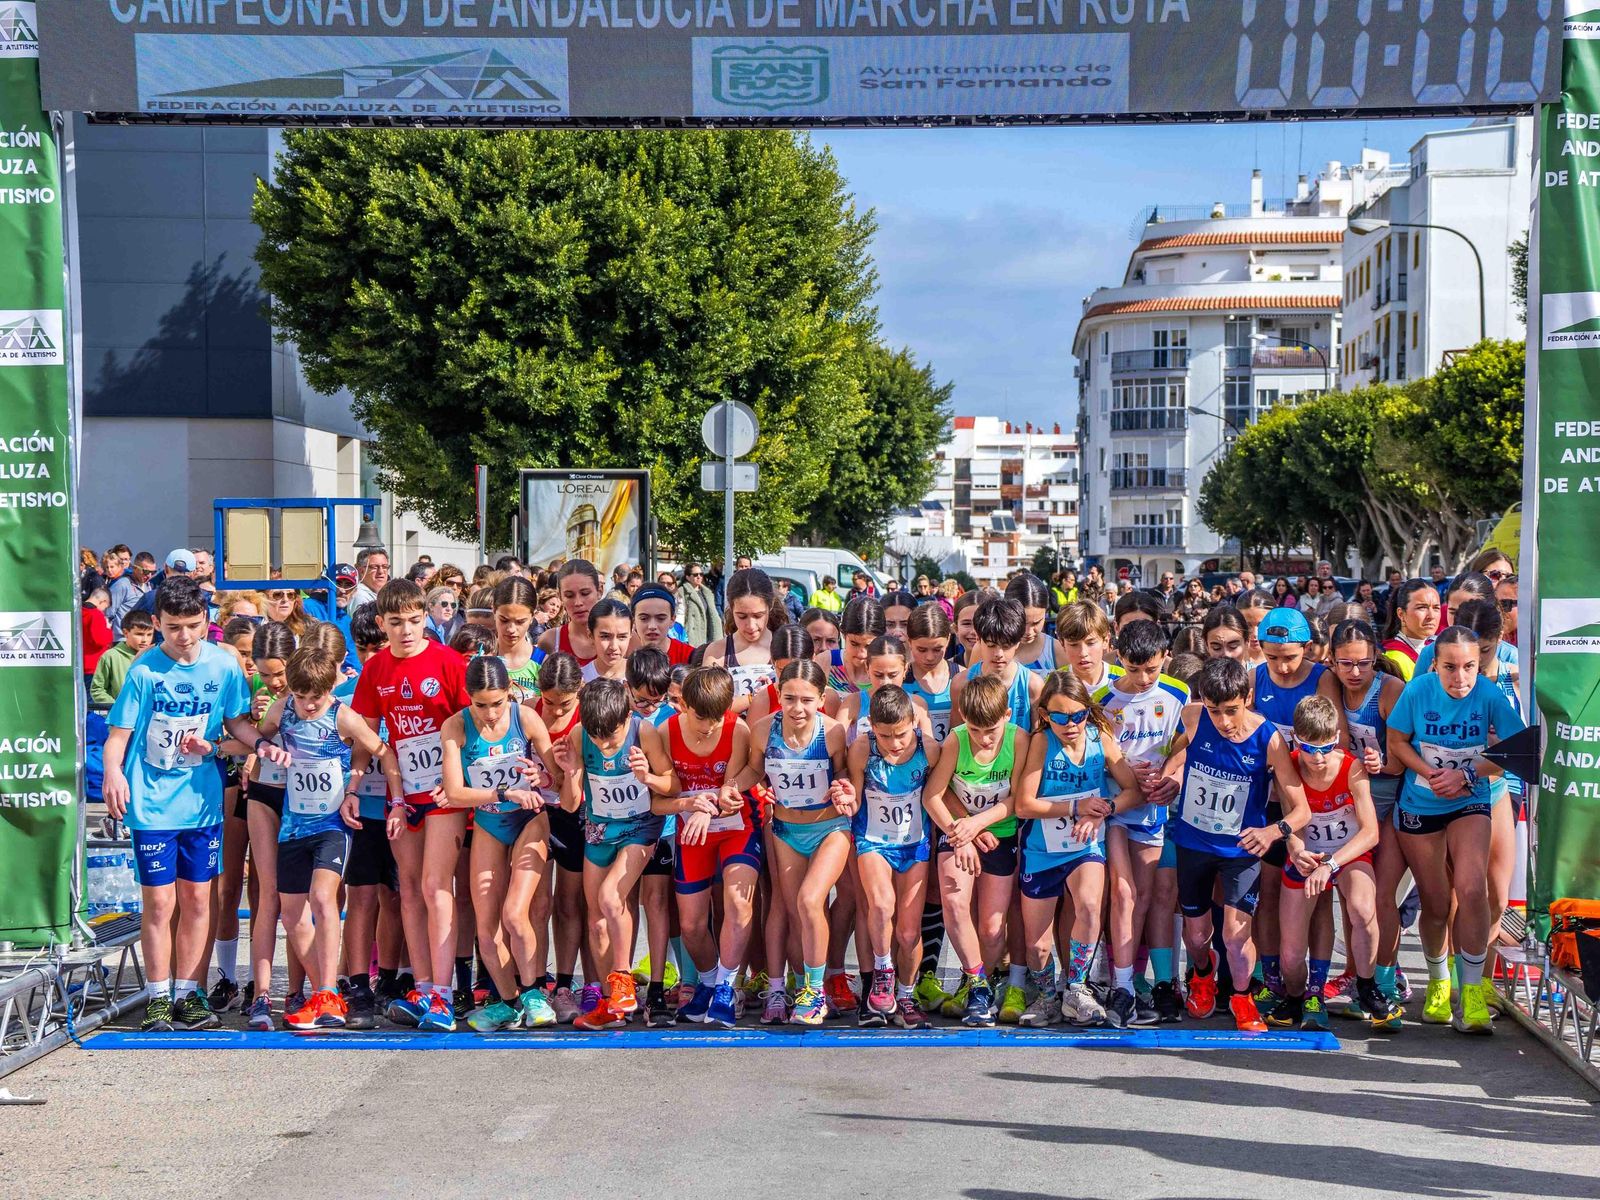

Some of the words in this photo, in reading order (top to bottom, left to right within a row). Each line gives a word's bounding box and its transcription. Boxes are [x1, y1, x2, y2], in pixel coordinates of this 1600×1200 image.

[859, 64, 1067, 79] Ayuntamiento
[1076, 63, 1112, 74] de
[859, 76, 926, 91] San
[936, 74, 1112, 90] Fernando
[146, 97, 275, 112] FEDERACIÓN
[286, 101, 401, 113] ANDALUZA
[411, 103, 438, 113] DE
[449, 103, 562, 114] ATLETISMO
[1545, 171, 1569, 187] DE
[1543, 477, 1569, 493] DE
[1545, 637, 1589, 646] FEDERACIÓN
[152, 696, 212, 717] nerja
[1425, 720, 1480, 740] nerja
[408, 746, 443, 772] 302
[0, 763, 55, 780] LUZA
[480, 766, 522, 789] 329
[778, 773, 816, 789] 341
[1194, 761, 1254, 783] TROTASIERRA
[294, 772, 332, 792] 308
[1541, 772, 1557, 793] DE
[599, 785, 639, 804] 300
[962, 790, 1000, 809] 304
[1194, 787, 1235, 813] 310
[879, 803, 914, 825] 303
[1307, 821, 1349, 841] 313
